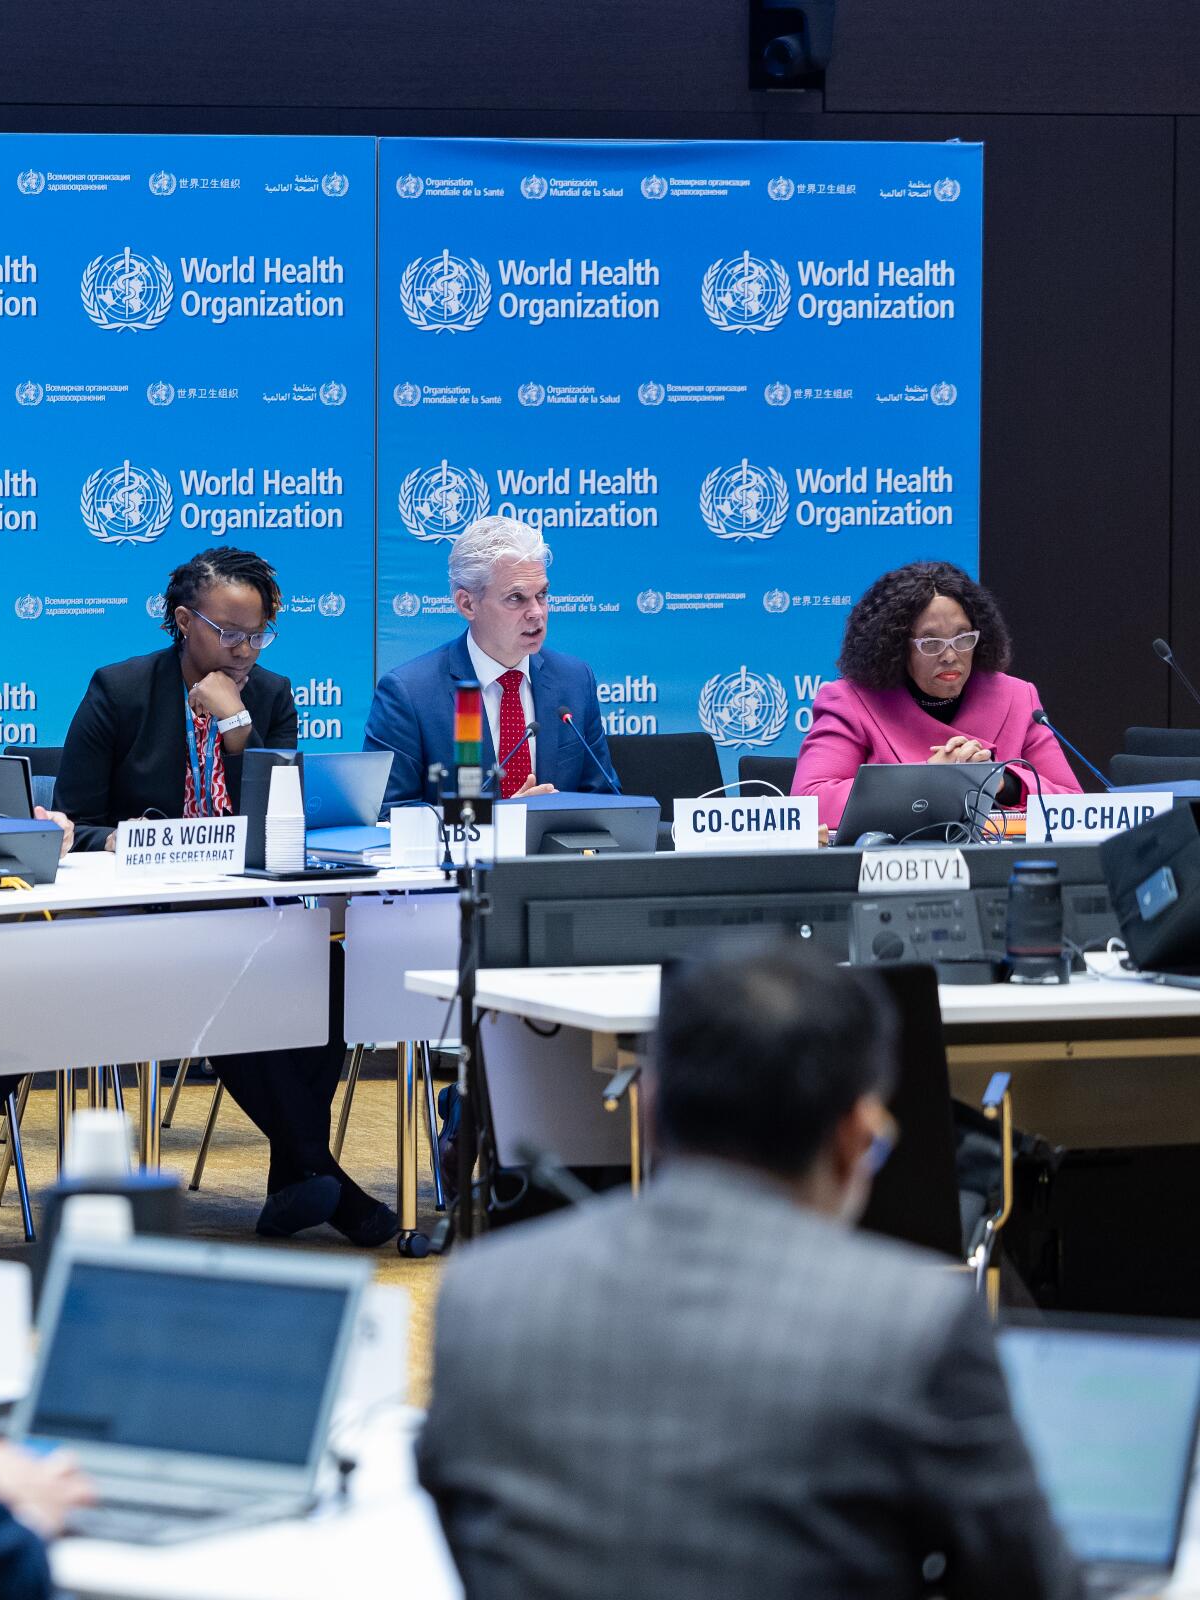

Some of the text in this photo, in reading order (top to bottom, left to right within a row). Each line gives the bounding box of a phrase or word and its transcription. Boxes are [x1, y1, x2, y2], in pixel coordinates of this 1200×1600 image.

[178, 177, 241, 190] 世界卫生组织
[425, 177, 474, 189] Organisation
[425, 187, 505, 197] mondiale de la Santé
[549, 177, 599, 189] Organización
[549, 187, 624, 197] Mundial de la Salud
[796, 183, 857, 195] 世界卫生组织
[180, 255, 345, 284] World Health
[498, 258, 661, 286] World Health
[797, 259, 956, 287] World Health
[180, 289, 345, 324] Organization
[498, 291, 660, 326] Organization
[797, 292, 956, 326] Organization
[176, 387, 239, 399] 世界卫生组织
[422, 385, 472, 397] Organisation
[422, 395, 502, 405] mondiale de la Santé
[546, 394, 621, 404] Mundial de la Salud
[792, 388, 853, 400] 世界卫生组织
[179, 467, 344, 496] World Health
[496, 467, 659, 495] World Health
[795, 465, 954, 494] World Health
[180, 501, 344, 536] Organization
[795, 498, 954, 533] Organization
[421, 594, 455, 606] Organisa
[577, 603, 589, 613] de
[589, 602, 597, 612] la
[598, 602, 620, 612] Salud
[791, 595, 852, 607] 世界卫生组织
[291, 677, 342, 706] alth
[596, 674, 657, 703] ealth
[691, 806, 803, 834] CO-CHAIR
[127, 823, 237, 848] INB & WGIHR
[125, 848, 235, 866] HEAD OF SECRETARIAT
[862, 857, 964, 882] MOBTV1
